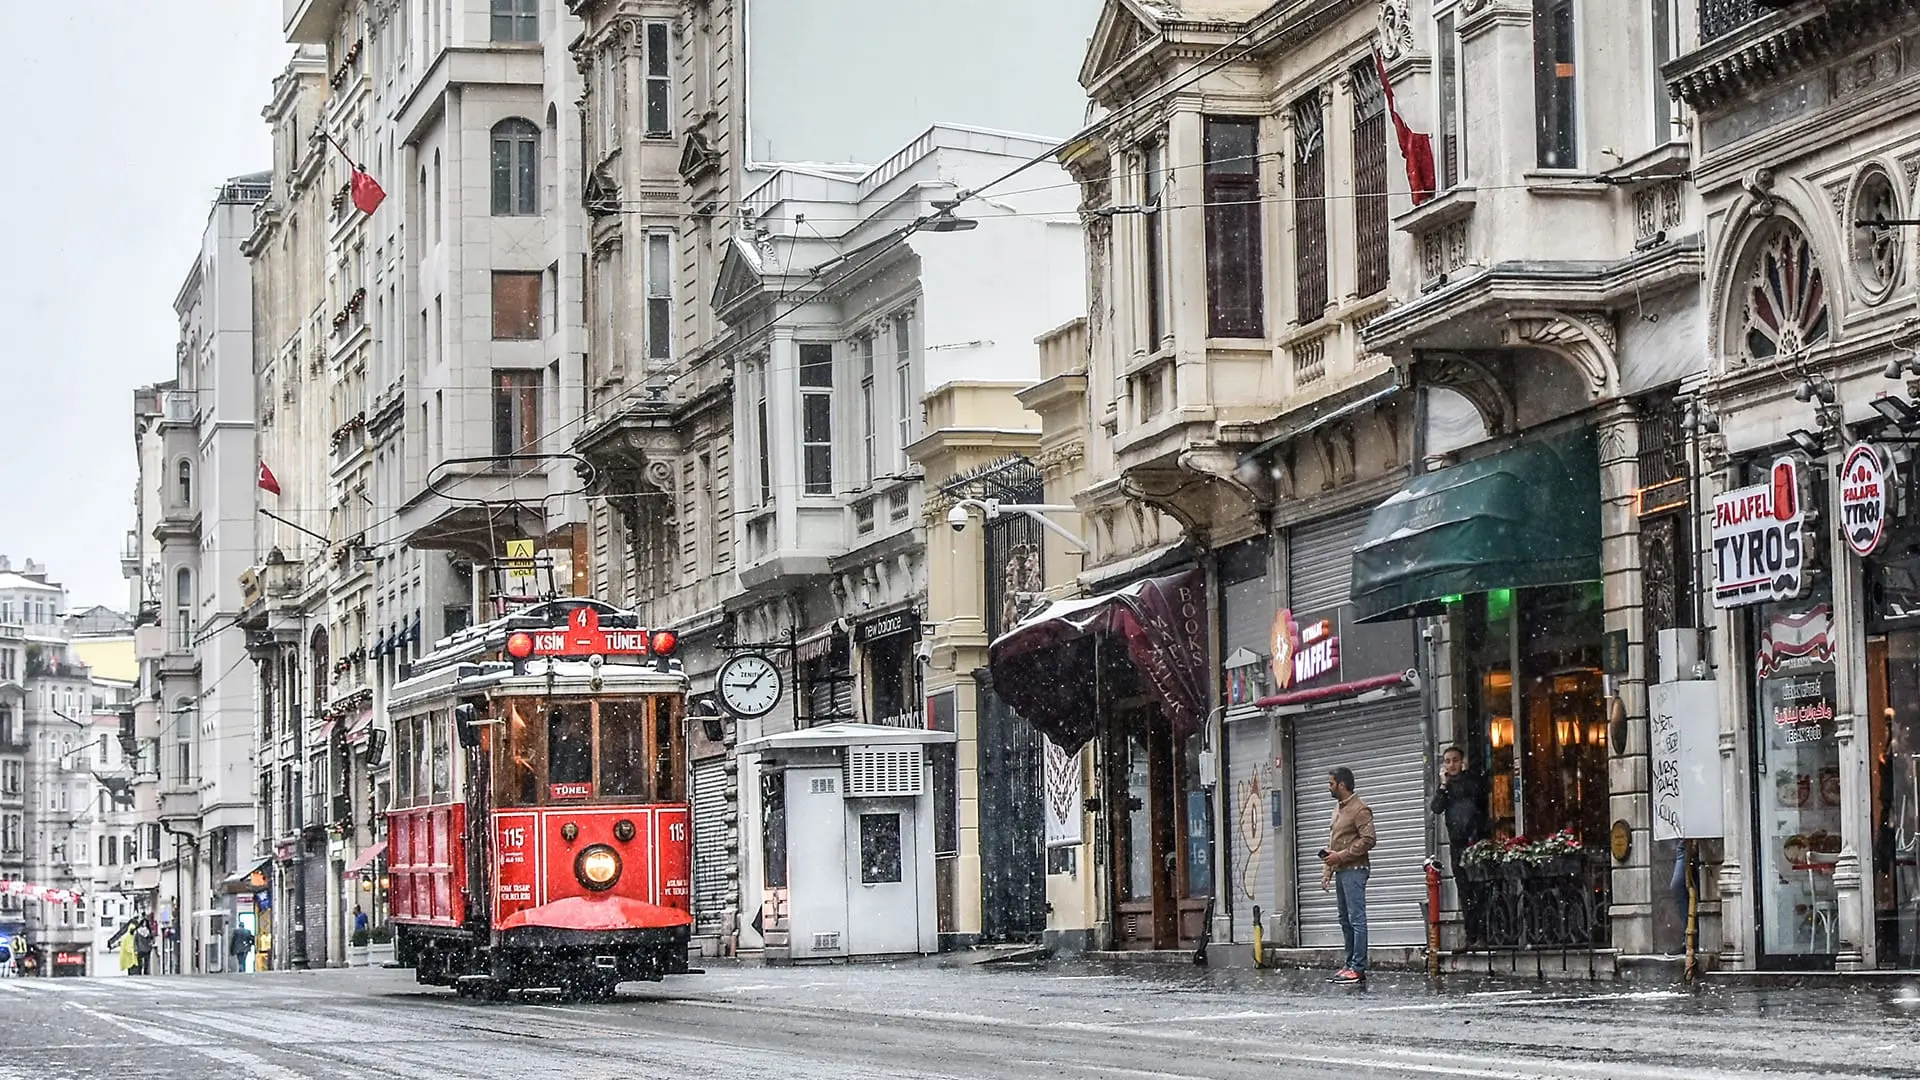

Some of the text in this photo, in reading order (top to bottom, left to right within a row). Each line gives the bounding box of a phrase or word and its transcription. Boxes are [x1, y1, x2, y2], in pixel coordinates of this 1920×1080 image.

[1844, 484, 1880, 502] FALAFEL
[1713, 493, 1773, 529] FALAFEL
[1844, 501, 1880, 525] TYROS
[1714, 521, 1800, 582] TYROS
[513, 568, 532, 577] VOLT
[576, 609, 587, 628] 4
[864, 615, 902, 639] new balance
[1179, 587, 1202, 667] BOOKS
[534, 632, 565, 650] KSİM
[604, 632, 647, 650] TÜNEL
[1295, 638, 1334, 684] WAFFLE
[1805, 724, 1822, 741] FOOD
[554, 785, 589, 795] TÜNEL
[504, 828, 525, 848] 115
[668, 823, 685, 841] 115
